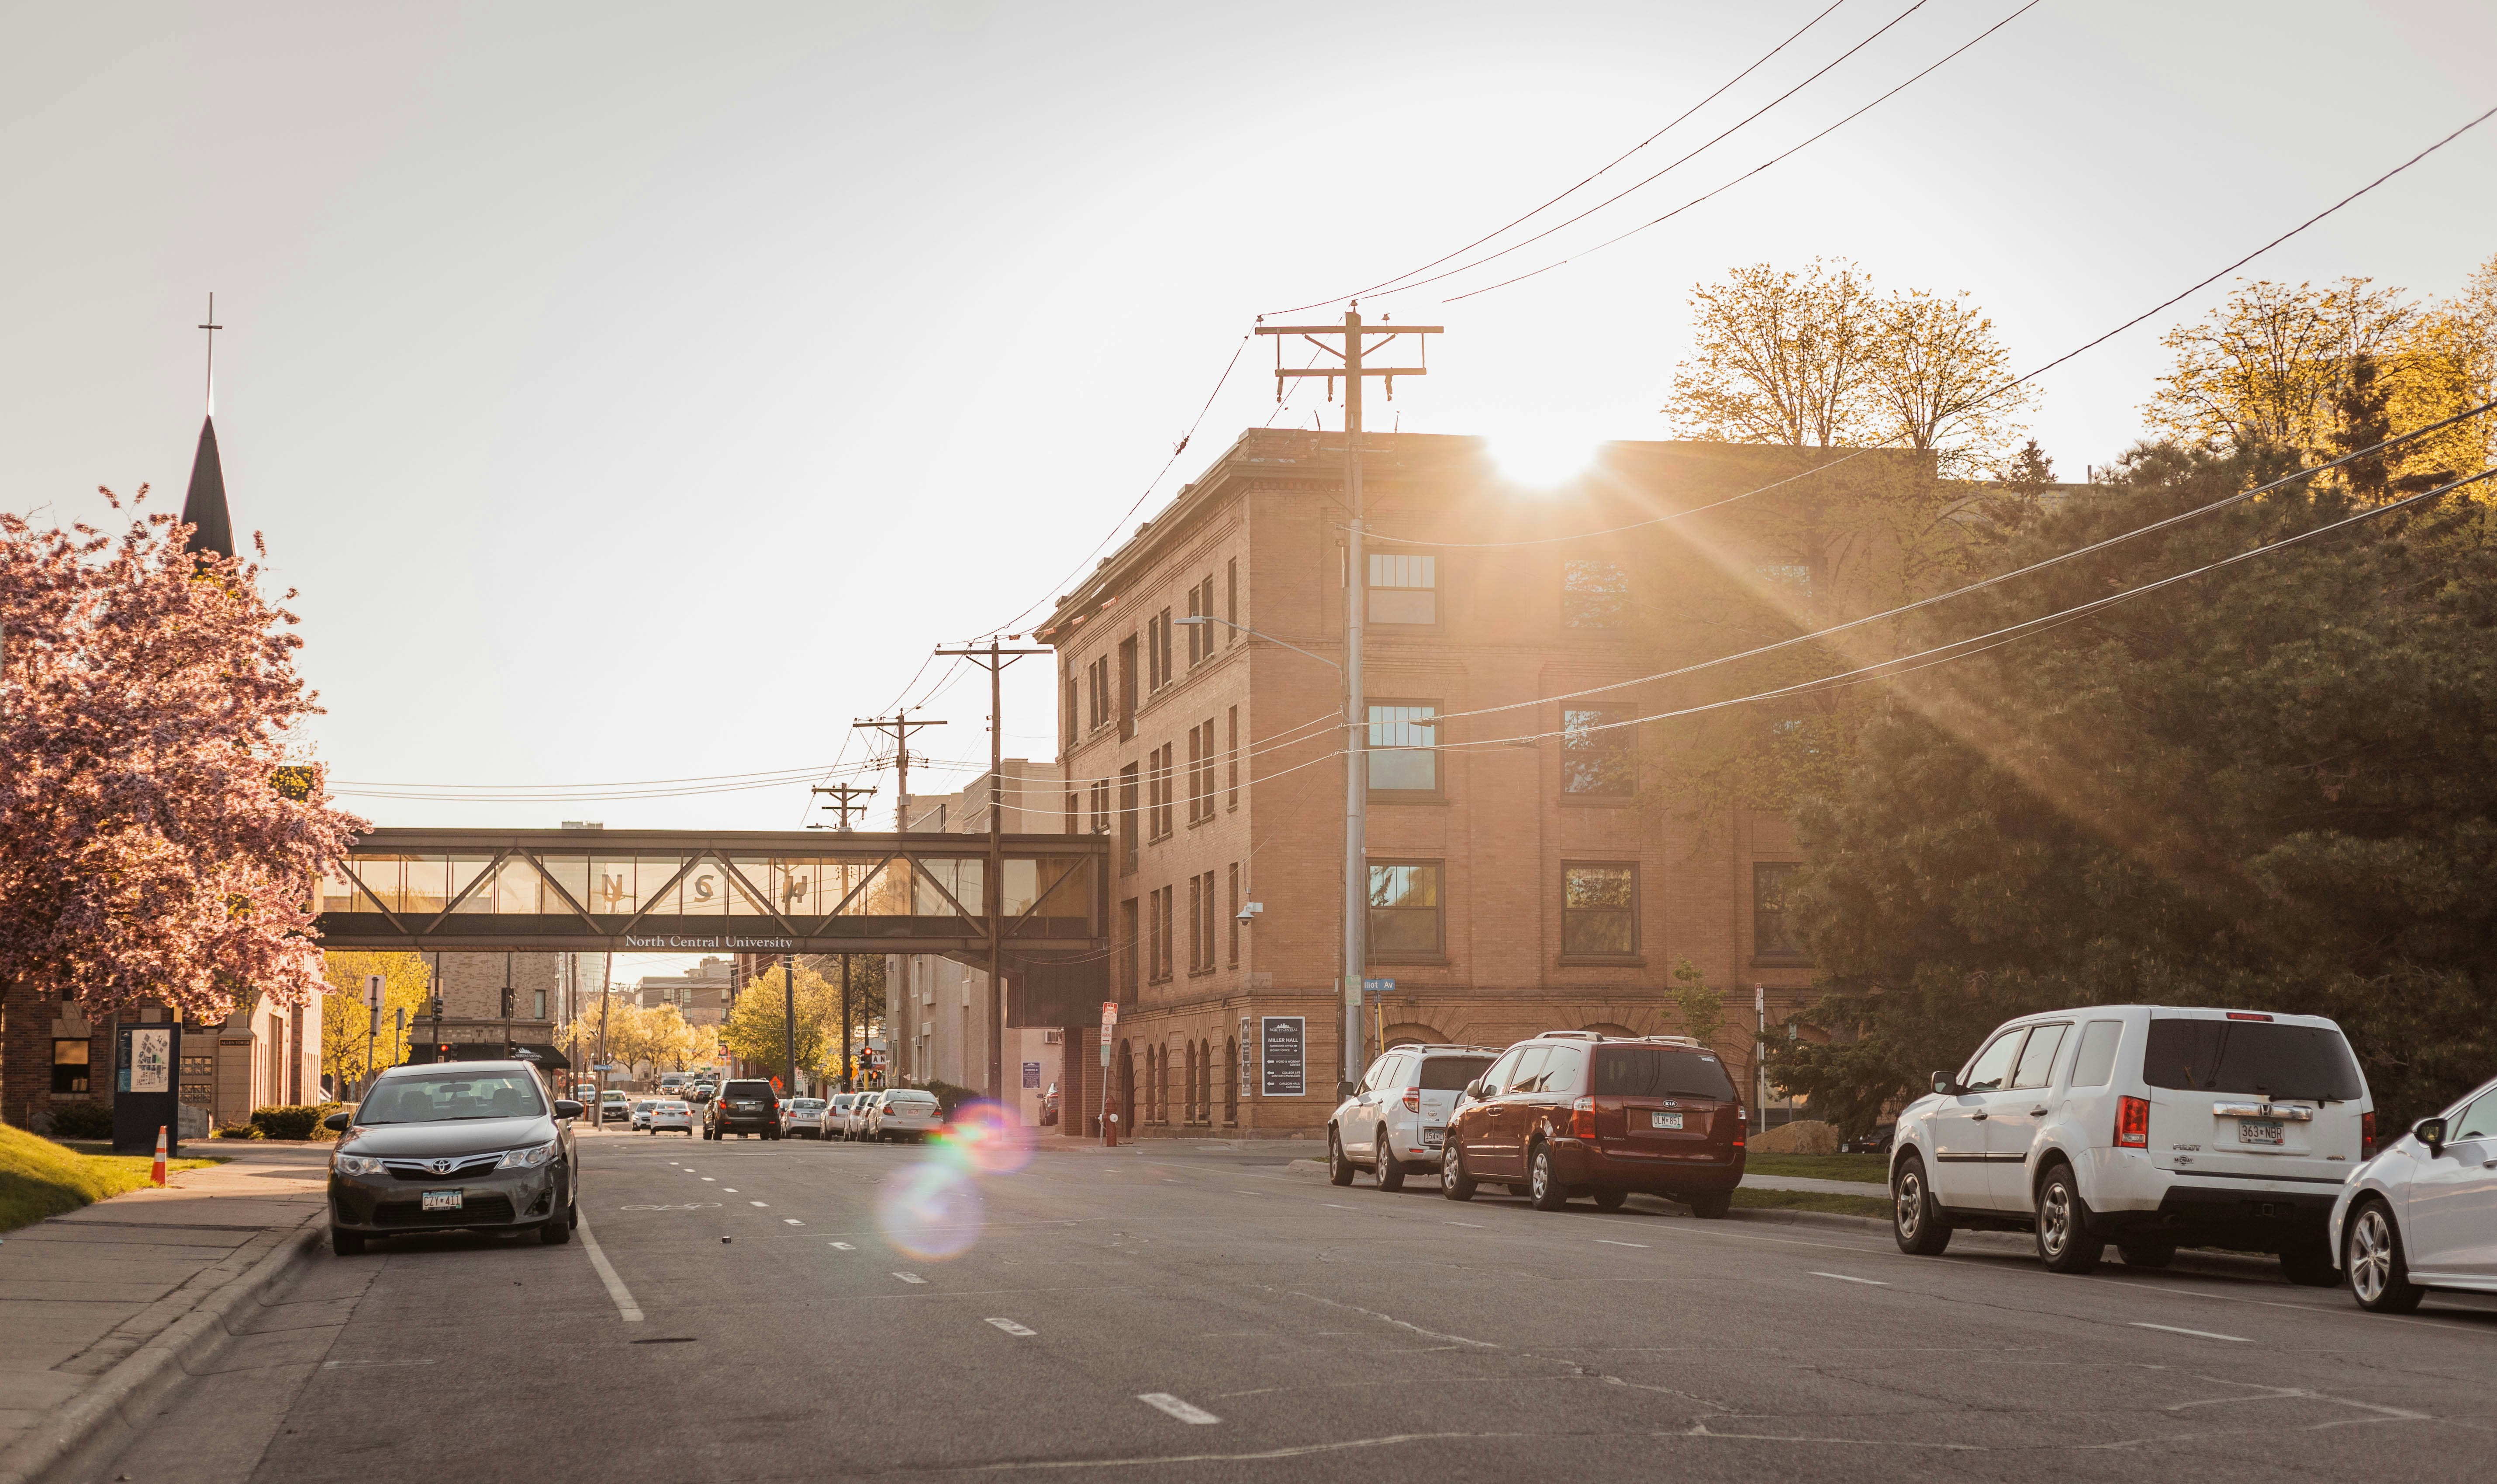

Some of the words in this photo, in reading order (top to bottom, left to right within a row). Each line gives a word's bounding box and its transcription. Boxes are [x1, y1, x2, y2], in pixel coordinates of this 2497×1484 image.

[625, 935, 665, 947] North
[670, 935, 719, 947] Central
[725, 936, 793, 948] University
[1654, 1116, 1665, 1125] DLM
[1669, 1117, 1681, 1125] 851
[2242, 1125, 2259, 1137] 363
[2265, 1127, 2282, 1139] NBR
[2173, 1143, 2202, 1151] PILOT
[424, 1196, 439, 1207] CZY
[445, 1195, 460, 1206] 411
